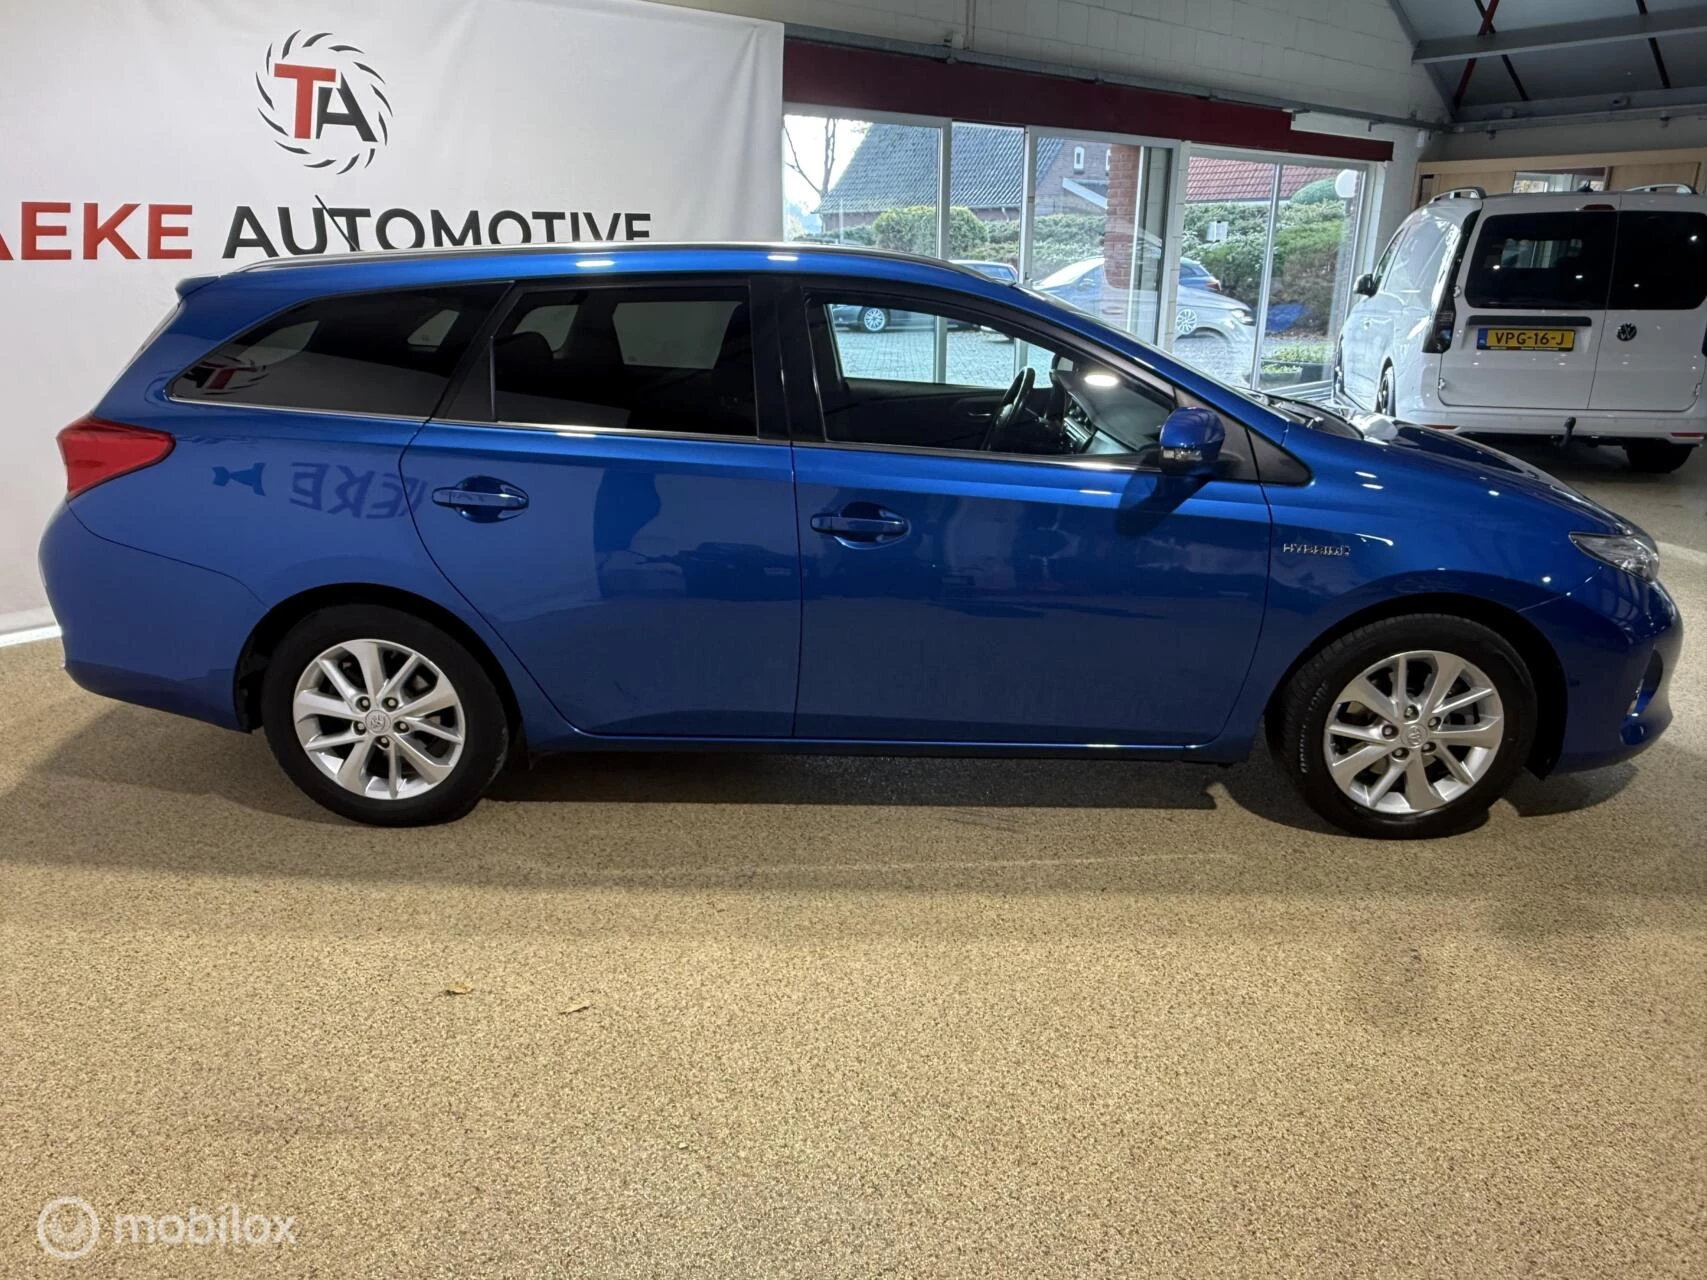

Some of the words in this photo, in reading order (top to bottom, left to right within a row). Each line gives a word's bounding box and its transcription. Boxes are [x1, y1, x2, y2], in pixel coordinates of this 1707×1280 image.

[274, 63, 378, 142] TA
[0, 202, 193, 260] EKE
[222, 206, 651, 258] AUTOMOTIVE
[1495, 332, 1565, 345] VPG-16-J
